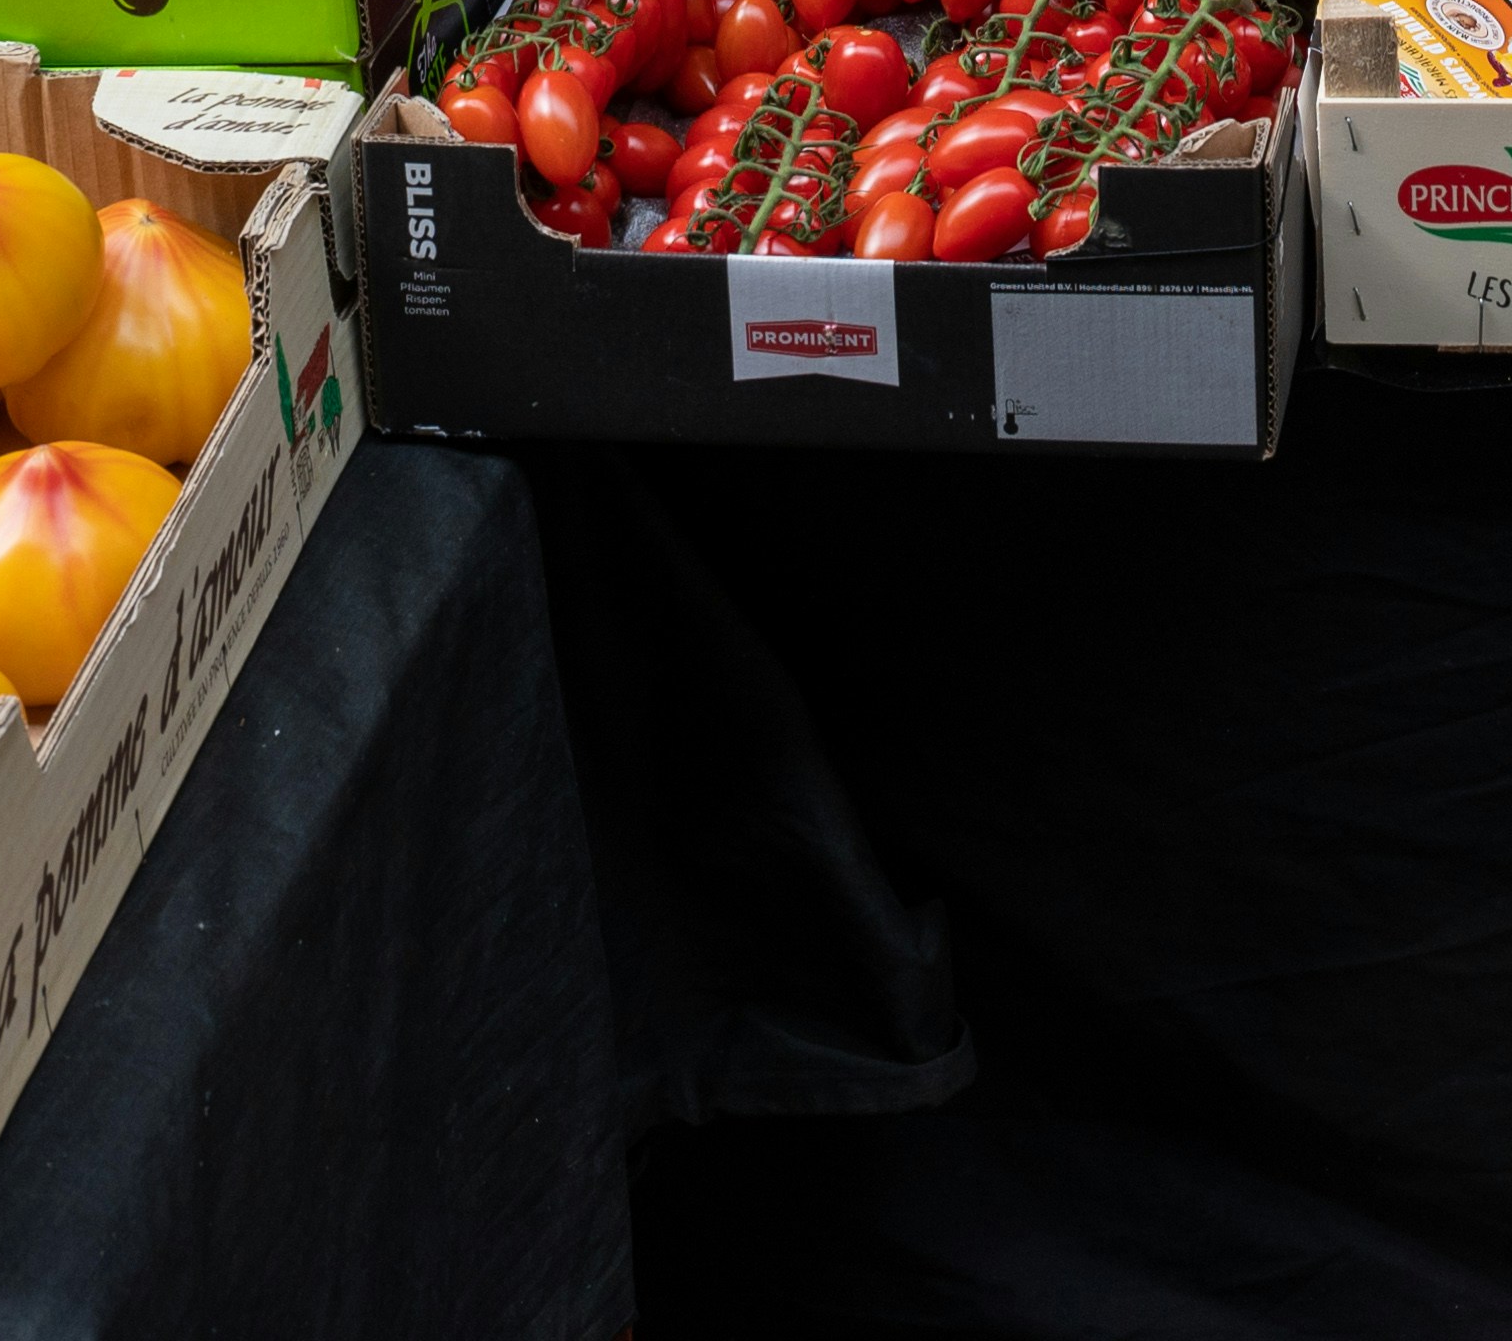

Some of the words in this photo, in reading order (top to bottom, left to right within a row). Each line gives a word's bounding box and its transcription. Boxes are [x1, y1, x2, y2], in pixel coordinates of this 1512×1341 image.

[417, 31, 437, 84] The
[403, 162, 437, 260] BLISS
[414, 272, 436, 281] Mini
[400, 282, 450, 293] Pflaumen
[990, 282, 1025, 291] Growers
[1027, 282, 1056, 291] United
[1183, 285, 1193, 293] LV
[1467, 269, 1510, 309] LES
[406, 294, 446, 304] Rispen-
[404, 307, 449, 316] tomaten
[752, 329, 872, 348] PROMINENT
[28, 695, 149, 1039] pomme
